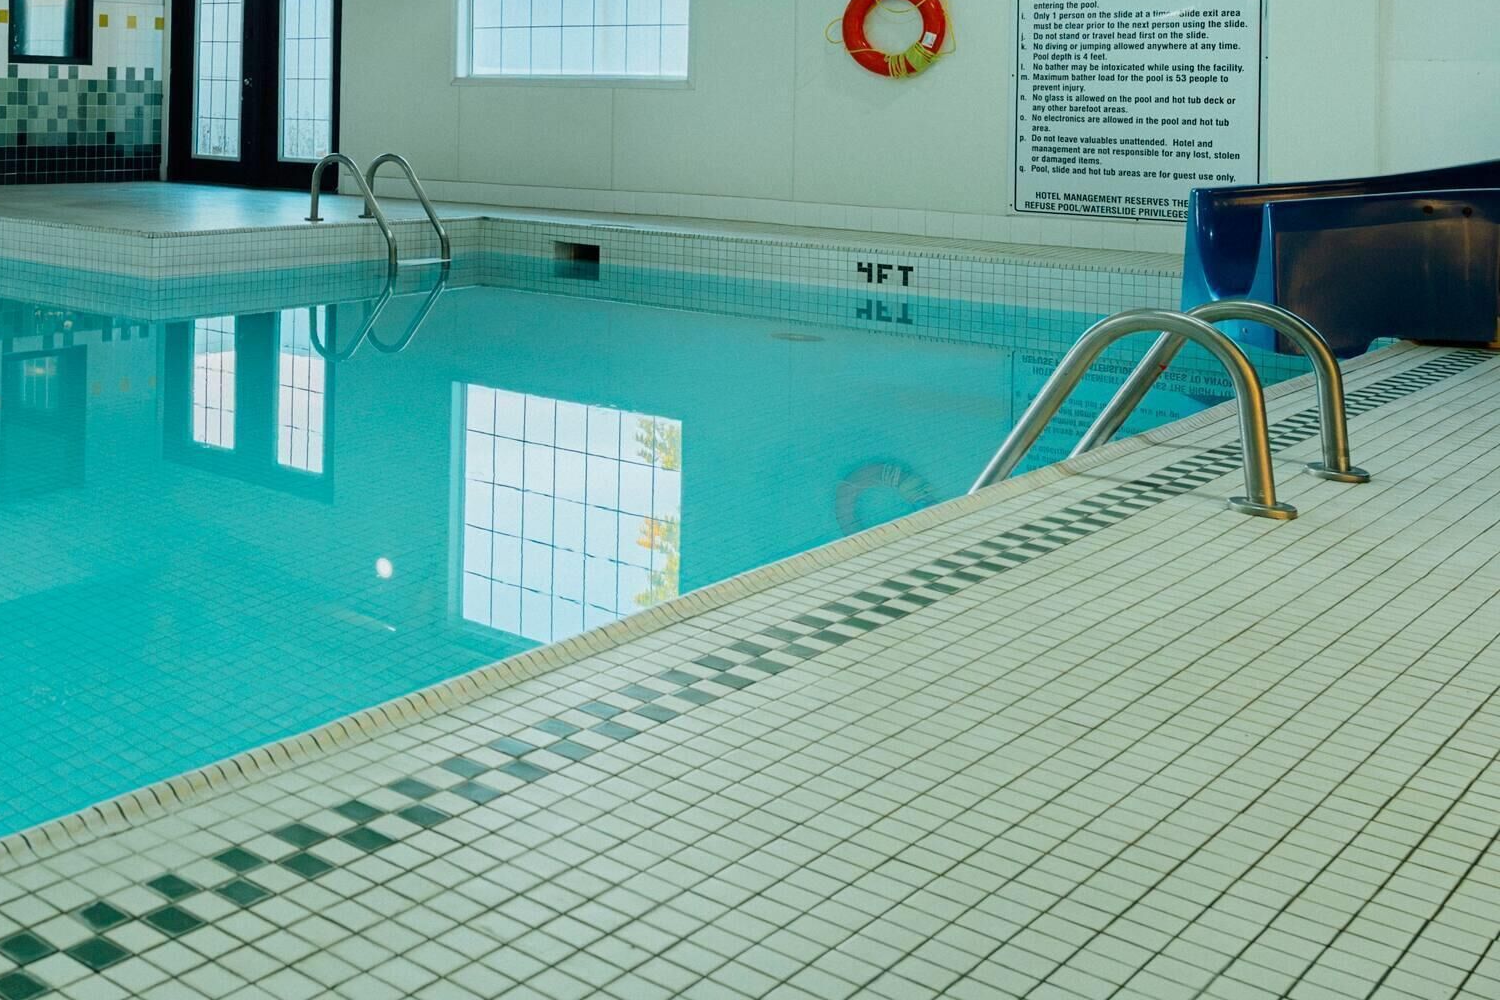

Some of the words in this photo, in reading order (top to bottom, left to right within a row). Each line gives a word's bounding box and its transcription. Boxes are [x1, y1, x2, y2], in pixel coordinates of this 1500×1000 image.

[1033, 1, 1065, 11] entering
[1033, 11, 1050, 21] Only
[1058, 12, 1085, 21] person
[1113, 10, 1133, 19] slide
[1033, 22, 1052, 30] must
[1064, 21, 1084, 30] clear
[1086, 21, 1105, 31] prior
[1131, 20, 1150, 29] next
[1151, 21, 1180, 30] person
[1182, 20, 1206, 30] using
[1224, 19, 1248, 28] slide.
[1058, 32, 1080, 40] stand
[1092, 31, 1115, 40] travel
[1139, 31, 1156, 40] first
[1185, 30, 1209, 39] slide.
[1045, 42, 1068, 52] diving
[1079, 42, 1112, 52] jumping
[1113, 41, 1145, 50] allowed
[1146, 42, 1188, 52] anywhere
[1050, 52, 1072, 62] depth
[1044, 62, 1069, 71] bather
[1101, 62, 1145, 72] intoxicated
[1147, 63, 1170, 72] while
[1171, 63, 1195, 74] using
[1213, 63, 1245, 74] facility.
[1032, 72, 1070, 81] Maximum
[1071, 73, 1096, 81] bather
[1188, 74, 1218, 84] people
[1032, 83, 1061, 93] prevent
[1062, 83, 1086, 93] injury.
[1044, 93, 1065, 103] glass
[1075, 94, 1106, 103] allowed
[1047, 104, 1067, 112] other
[1068, 104, 1102, 113] barefoot
[1103, 106, 1129, 114] areas.
[1043, 113, 1086, 123] electronics
[1102, 115, 1134, 124] allowed
[1057, 135, 1078, 144] leave
[1079, 136, 1118, 145] valuables
[1119, 137, 1168, 147] unattended.
[1172, 138, 1195, 148] Hotel
[1031, 145, 1081, 154] management
[1112, 148, 1160, 157] responsible
[1213, 151, 1240, 160] stolen
[1041, 154, 1077, 165] damaged
[1078, 156, 1103, 165] items.
[1051, 165, 1070, 174] slide
[1118, 169, 1141, 178] areas
[1172, 172, 1196, 181] guest
[1035, 191, 1061, 201] HOTEL
[1063, 192, 1123, 204] MANAGEMENT
[1124, 196, 1170, 207] RESERVES
[1024, 200, 1056, 211] REFUSE
[1057, 203, 1136, 216] POOL/WATERSLIDE
[1138, 207, 1188, 220] PRIVILEGES
[857, 262, 914, 286] 4FT
